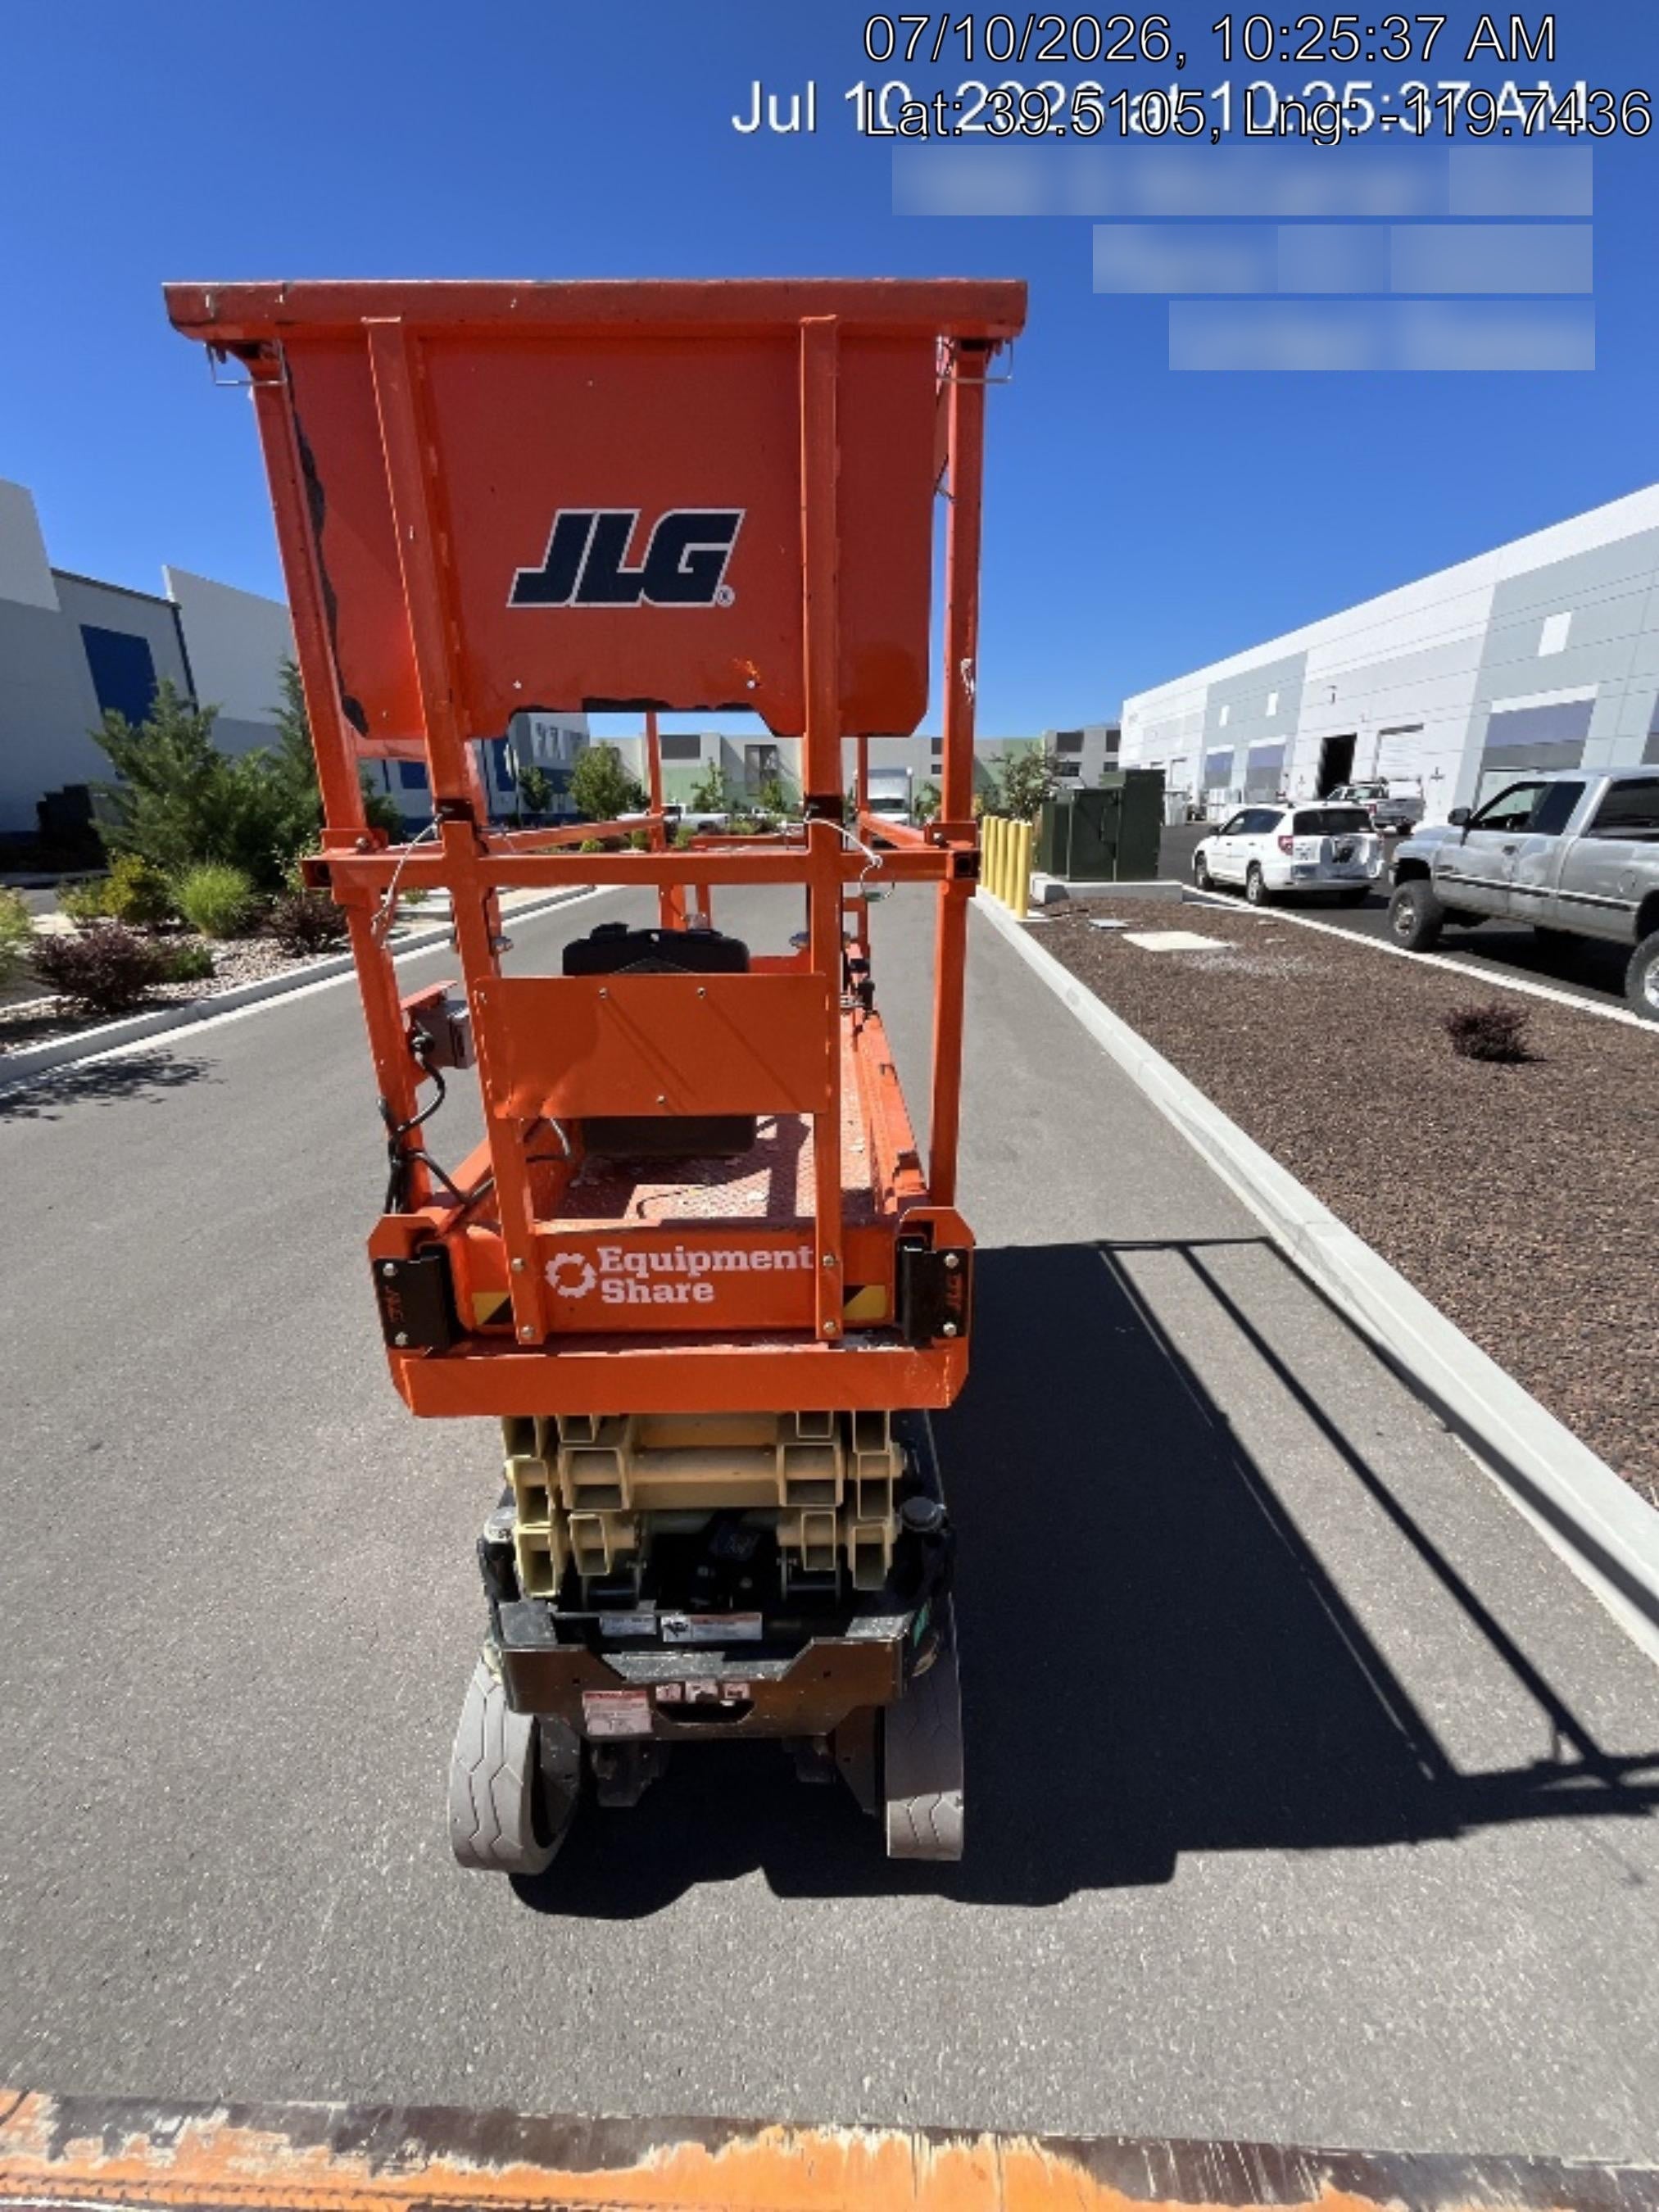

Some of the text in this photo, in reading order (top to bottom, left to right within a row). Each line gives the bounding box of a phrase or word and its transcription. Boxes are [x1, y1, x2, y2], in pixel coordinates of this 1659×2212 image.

[506, 508, 746, 608] JLG
[596, 1245, 814, 1279] Equipment
[601, 1278, 715, 1303] Share
